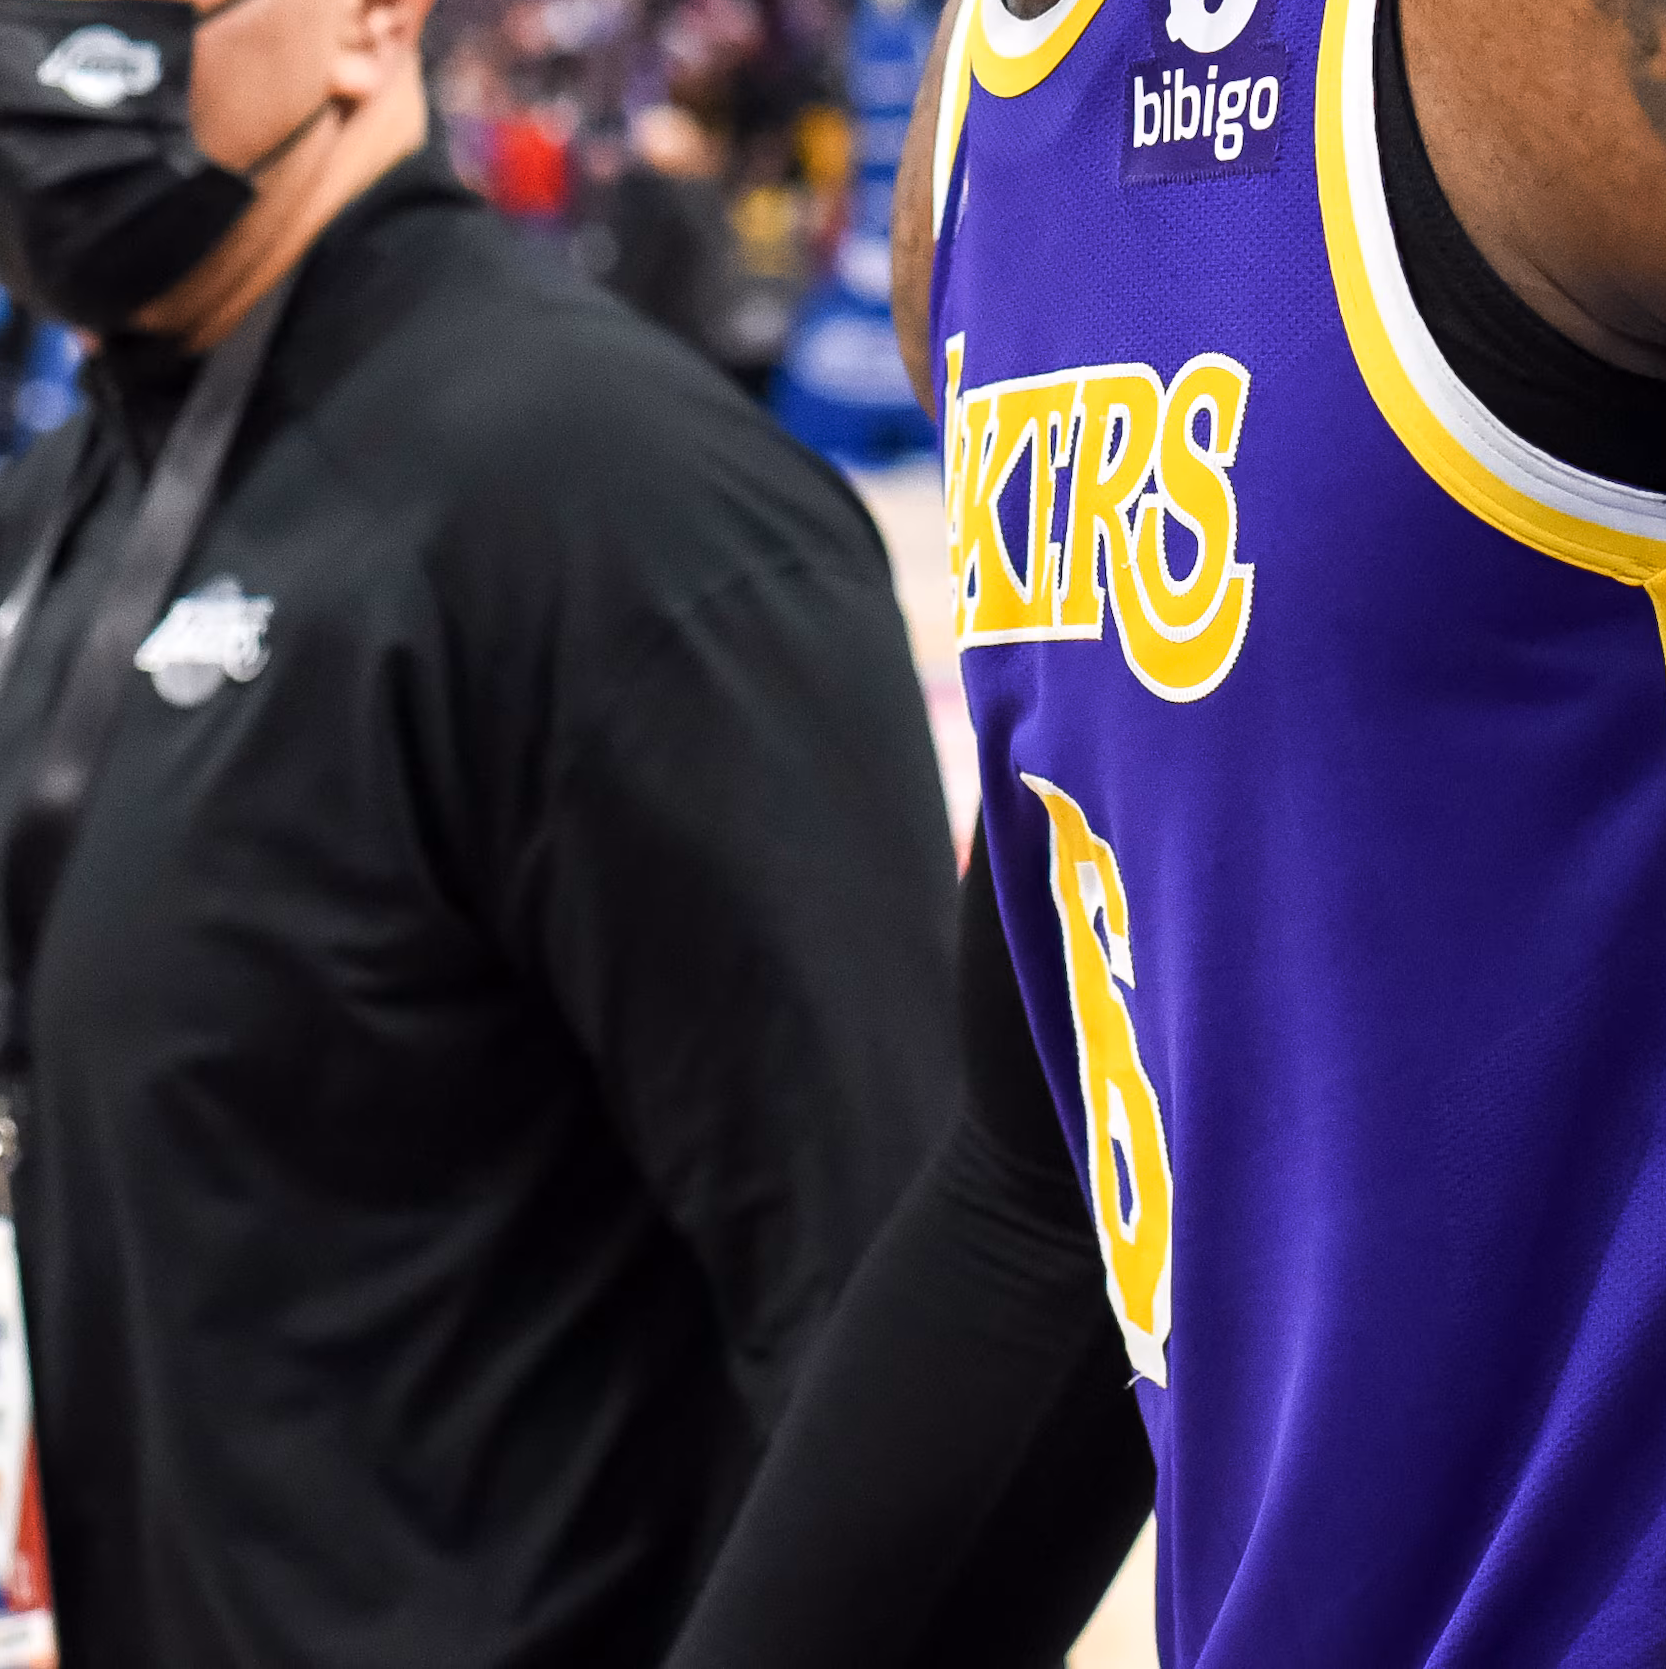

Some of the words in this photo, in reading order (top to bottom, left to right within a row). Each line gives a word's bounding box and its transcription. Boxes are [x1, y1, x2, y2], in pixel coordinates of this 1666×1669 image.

[1132, 64, 1279, 162] bibigo
[944, 331, 1256, 703] KERS
[1020, 772, 1174, 1389] 6
